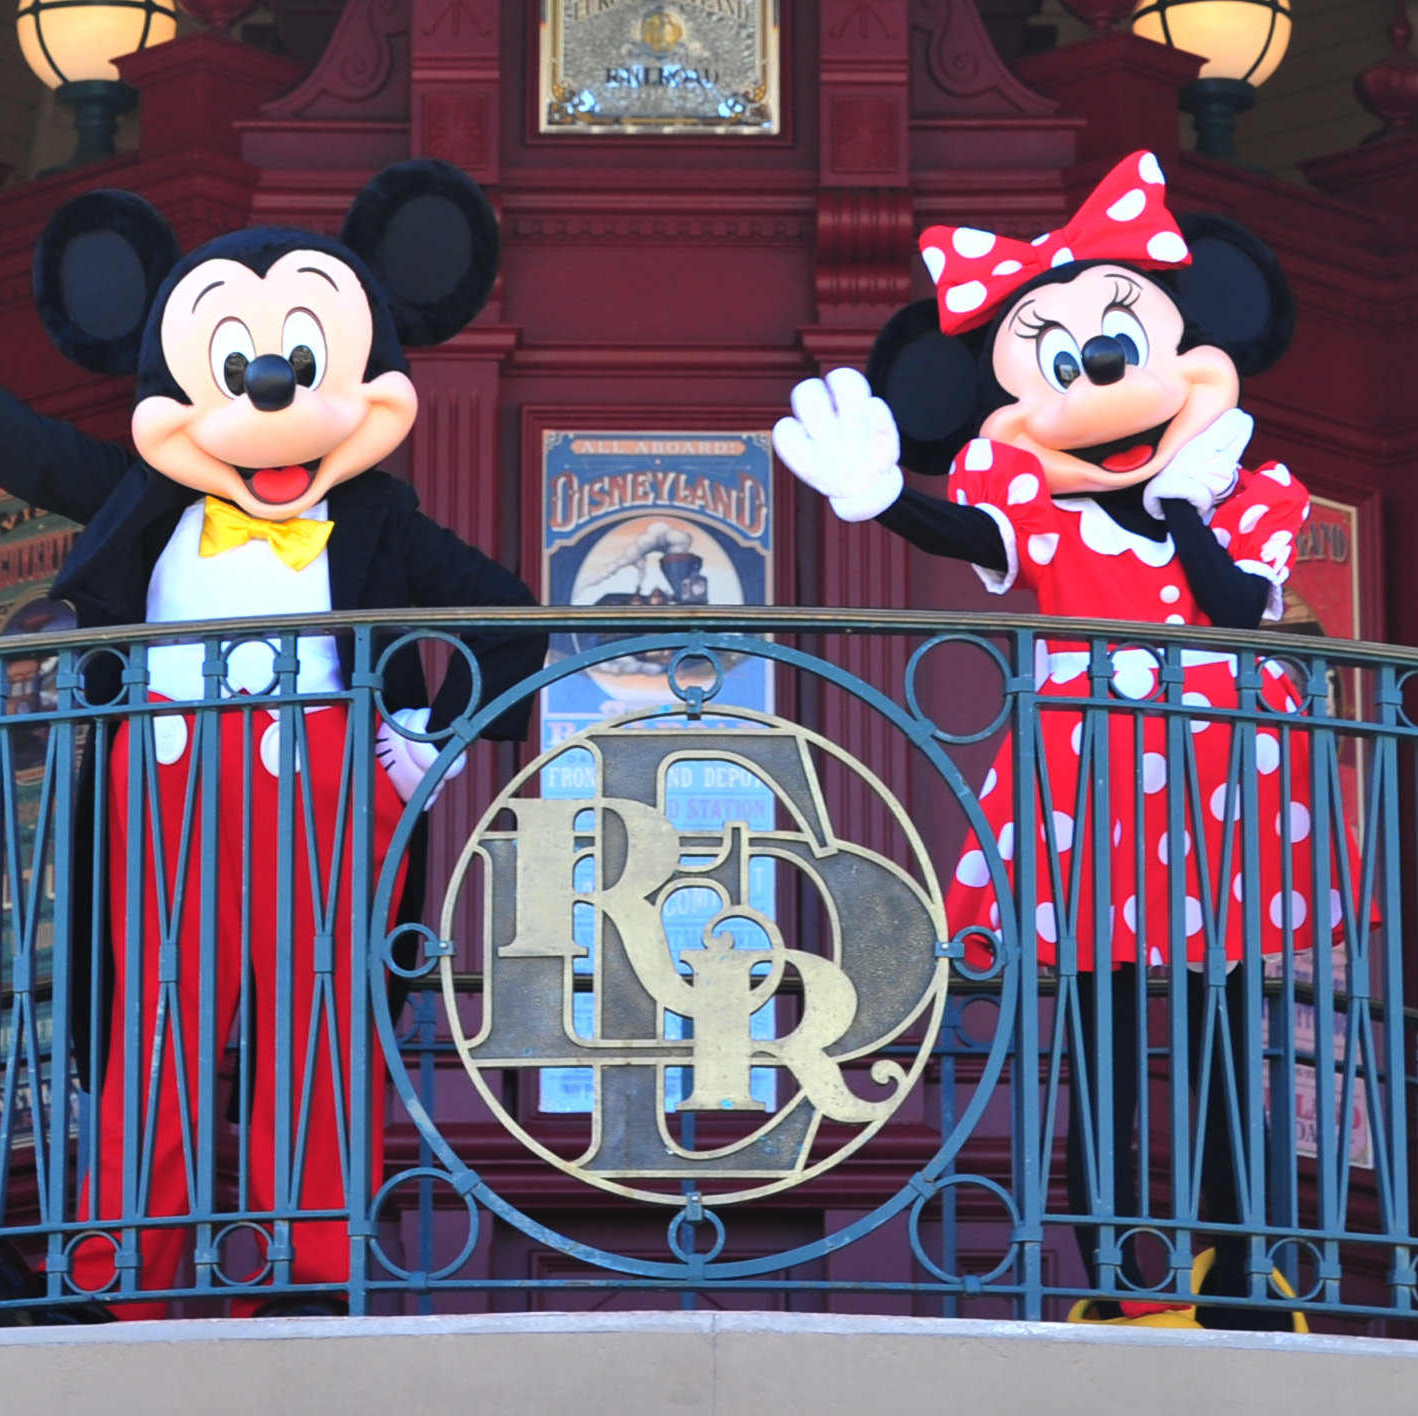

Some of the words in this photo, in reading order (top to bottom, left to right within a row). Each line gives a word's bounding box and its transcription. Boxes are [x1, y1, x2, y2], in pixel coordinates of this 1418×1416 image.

[582, 440, 626, 454] ALL
[635, 440, 736, 455] ABOARD!
[550, 471, 768, 538] DISNEYLAND
[688, 798, 765, 819] STATION
